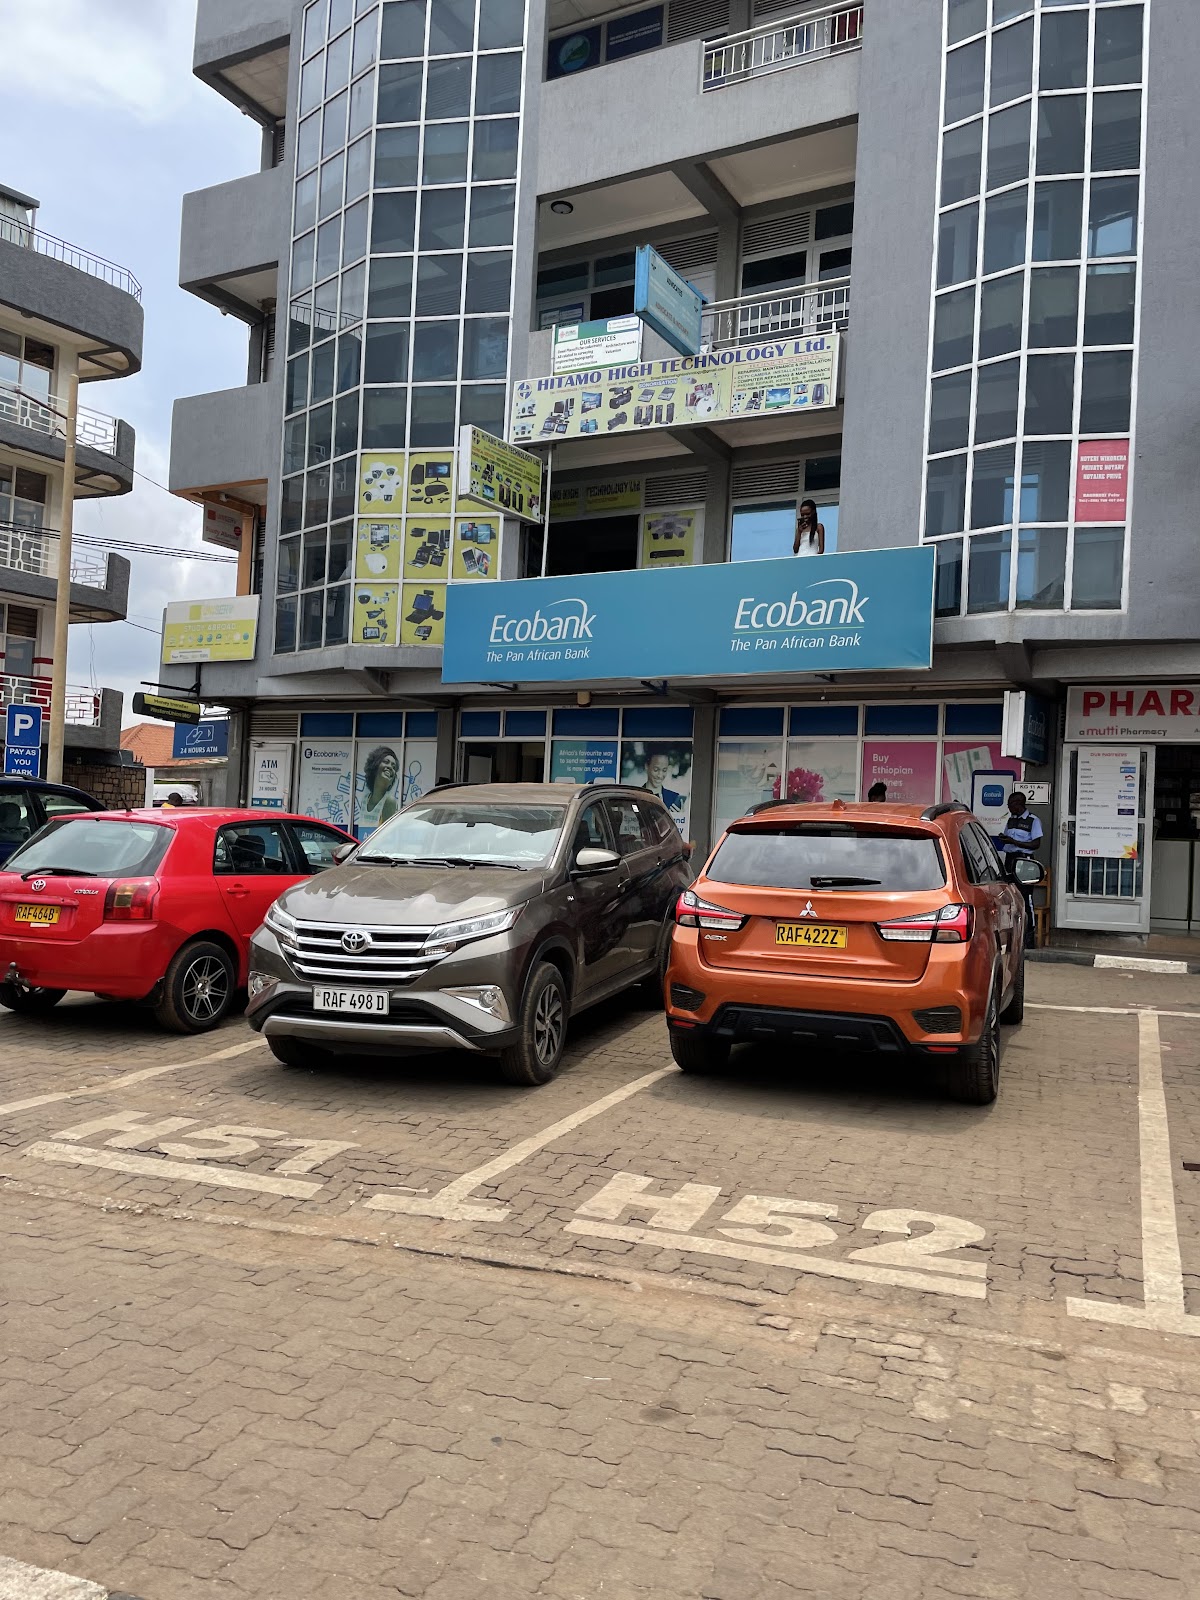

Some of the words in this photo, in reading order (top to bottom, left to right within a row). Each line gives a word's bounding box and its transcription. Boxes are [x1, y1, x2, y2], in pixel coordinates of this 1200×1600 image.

[592, 334, 617, 344] SERVICES
[537, 371, 602, 391] HITAMO
[608, 363, 653, 380] HIGH
[659, 343, 787, 373] TECHNOLOGY
[794, 338, 831, 354] Ltd.
[734, 578, 870, 630] Ecobank
[489, 598, 597, 644] Ecobank
[730, 638, 750, 652] The
[754, 637, 778, 651] Pan
[780, 635, 825, 649] African
[828, 633, 862, 647] Bank
[486, 651, 503, 662] The
[506, 651, 524, 662] Pan
[526, 648, 562, 662] African
[564, 647, 590, 660] Bank
[1082, 690, 1200, 716] PHAR
[14, 714, 33, 736] P
[1086, 726, 1118, 736] mutti
[1120, 728, 1168, 737] Pharmacy
[314, 751, 350, 759] EcobankPay
[873, 754, 889, 763] Buy
[261, 760, 278, 768] ATM
[872, 766, 913, 776] Ethiopian
[1028, 790, 1035, 800] 2
[16, 905, 55, 921] RAF464B
[704, 933, 728, 942] ASX
[777, 926, 839, 945] RAF422Z
[322, 991, 346, 1008] RAF
[349, 992, 373, 1010] 498
[377, 996, 384, 1010] D
[573, 1171, 988, 1279] H52
